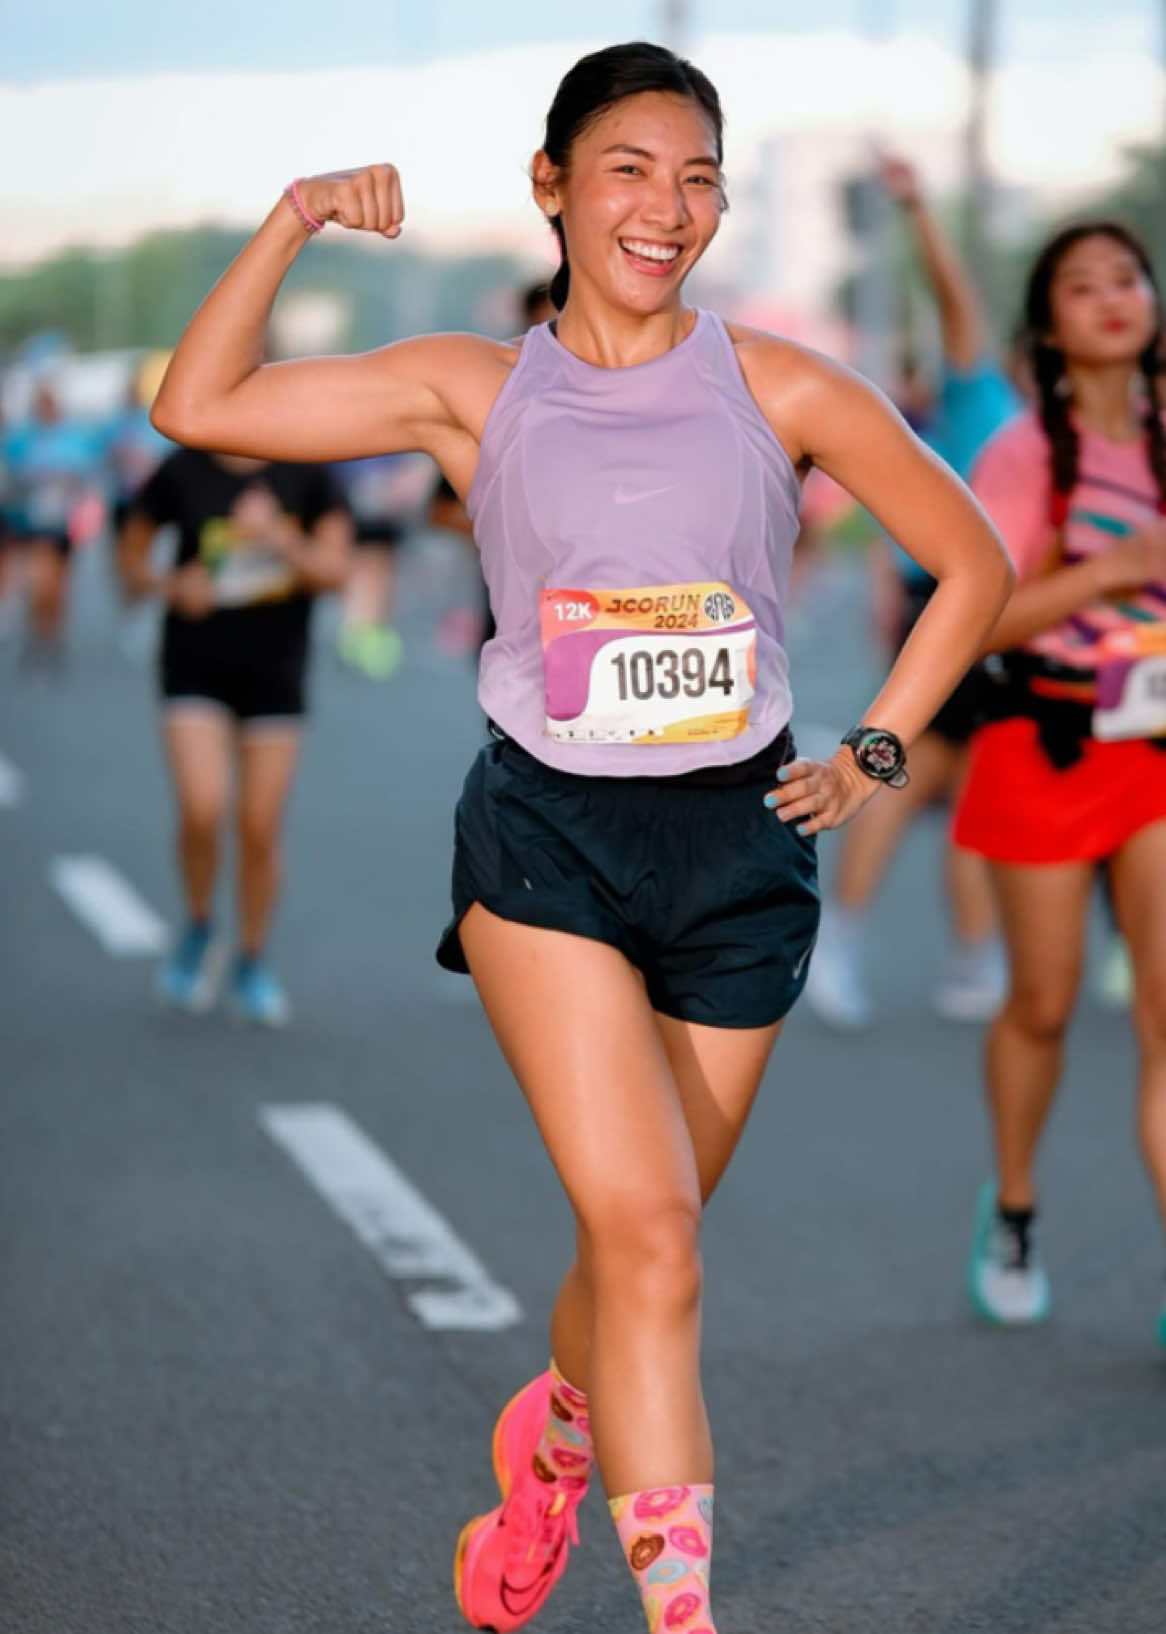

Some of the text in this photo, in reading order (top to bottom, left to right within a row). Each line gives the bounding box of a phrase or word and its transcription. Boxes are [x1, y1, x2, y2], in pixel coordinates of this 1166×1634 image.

[554, 602, 593, 621] 12K
[654, 613, 699, 629] 2024
[611, 648, 734, 701] 10394
